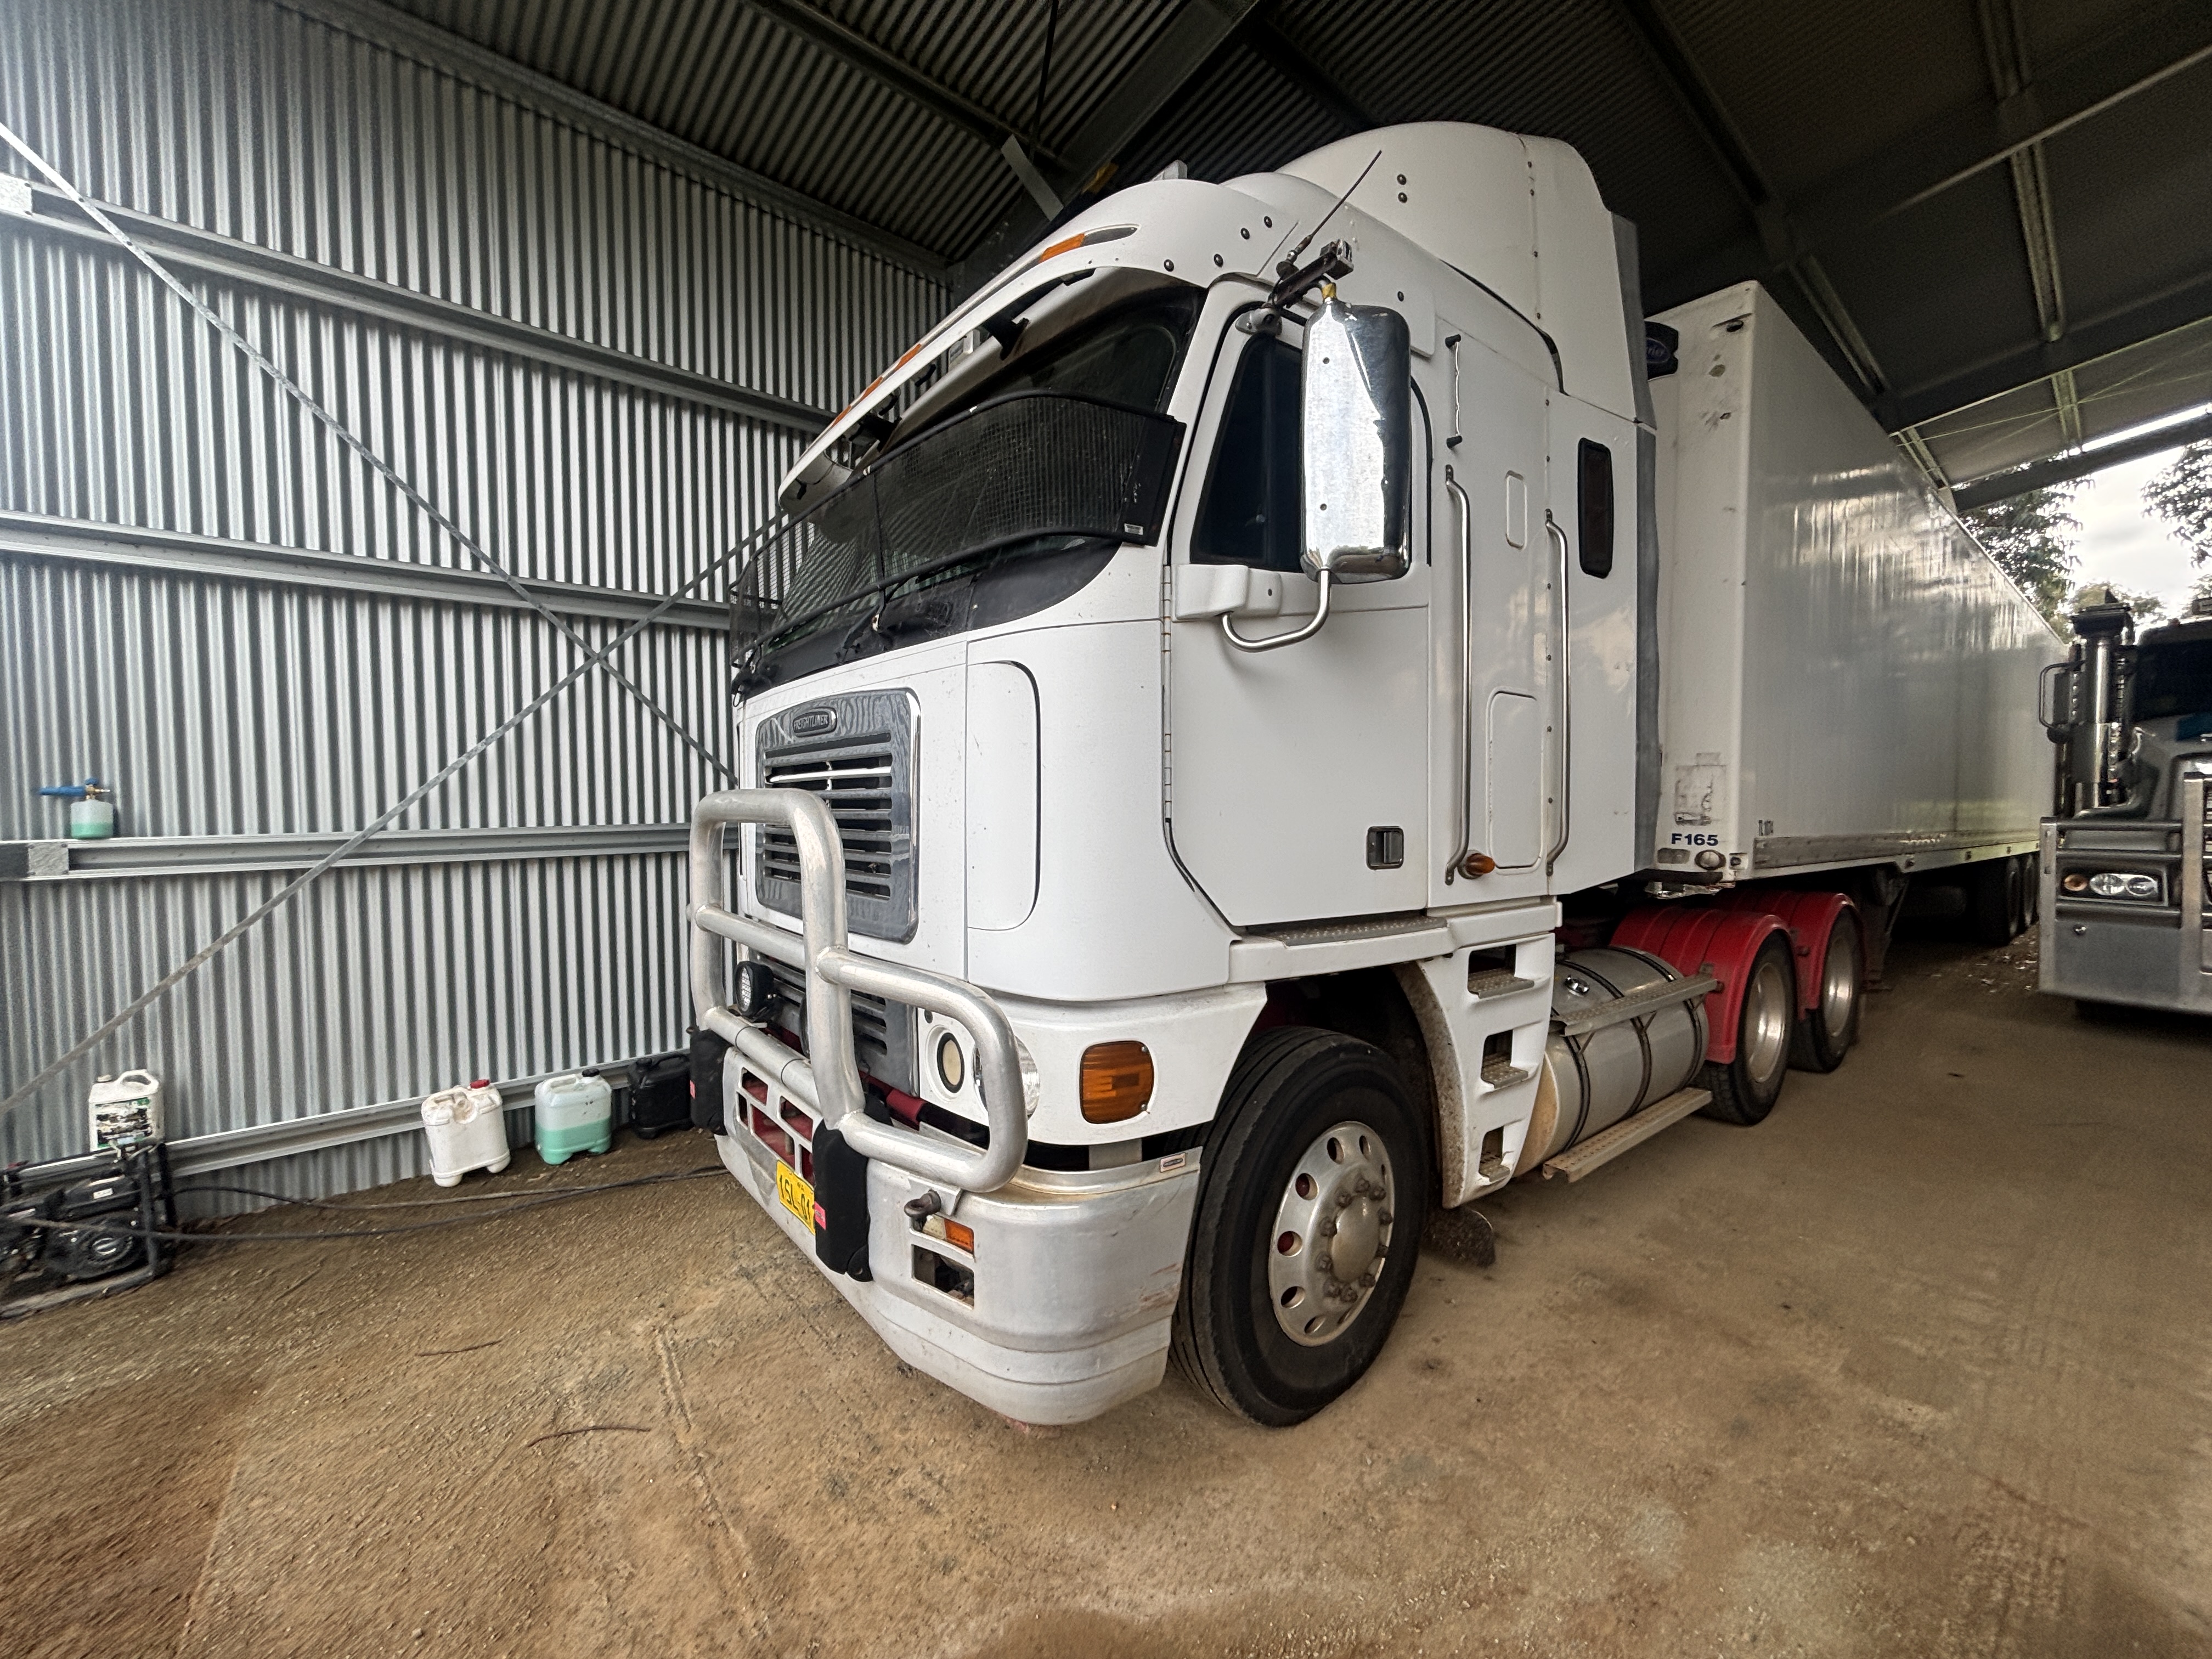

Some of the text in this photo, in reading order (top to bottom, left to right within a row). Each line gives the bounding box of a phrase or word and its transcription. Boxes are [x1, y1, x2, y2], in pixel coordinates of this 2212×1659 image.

[794, 714, 828, 730] FREIGHTLINER
[1671, 833, 1718, 846] F165
[779, 1174, 815, 1224] 1SL-01
